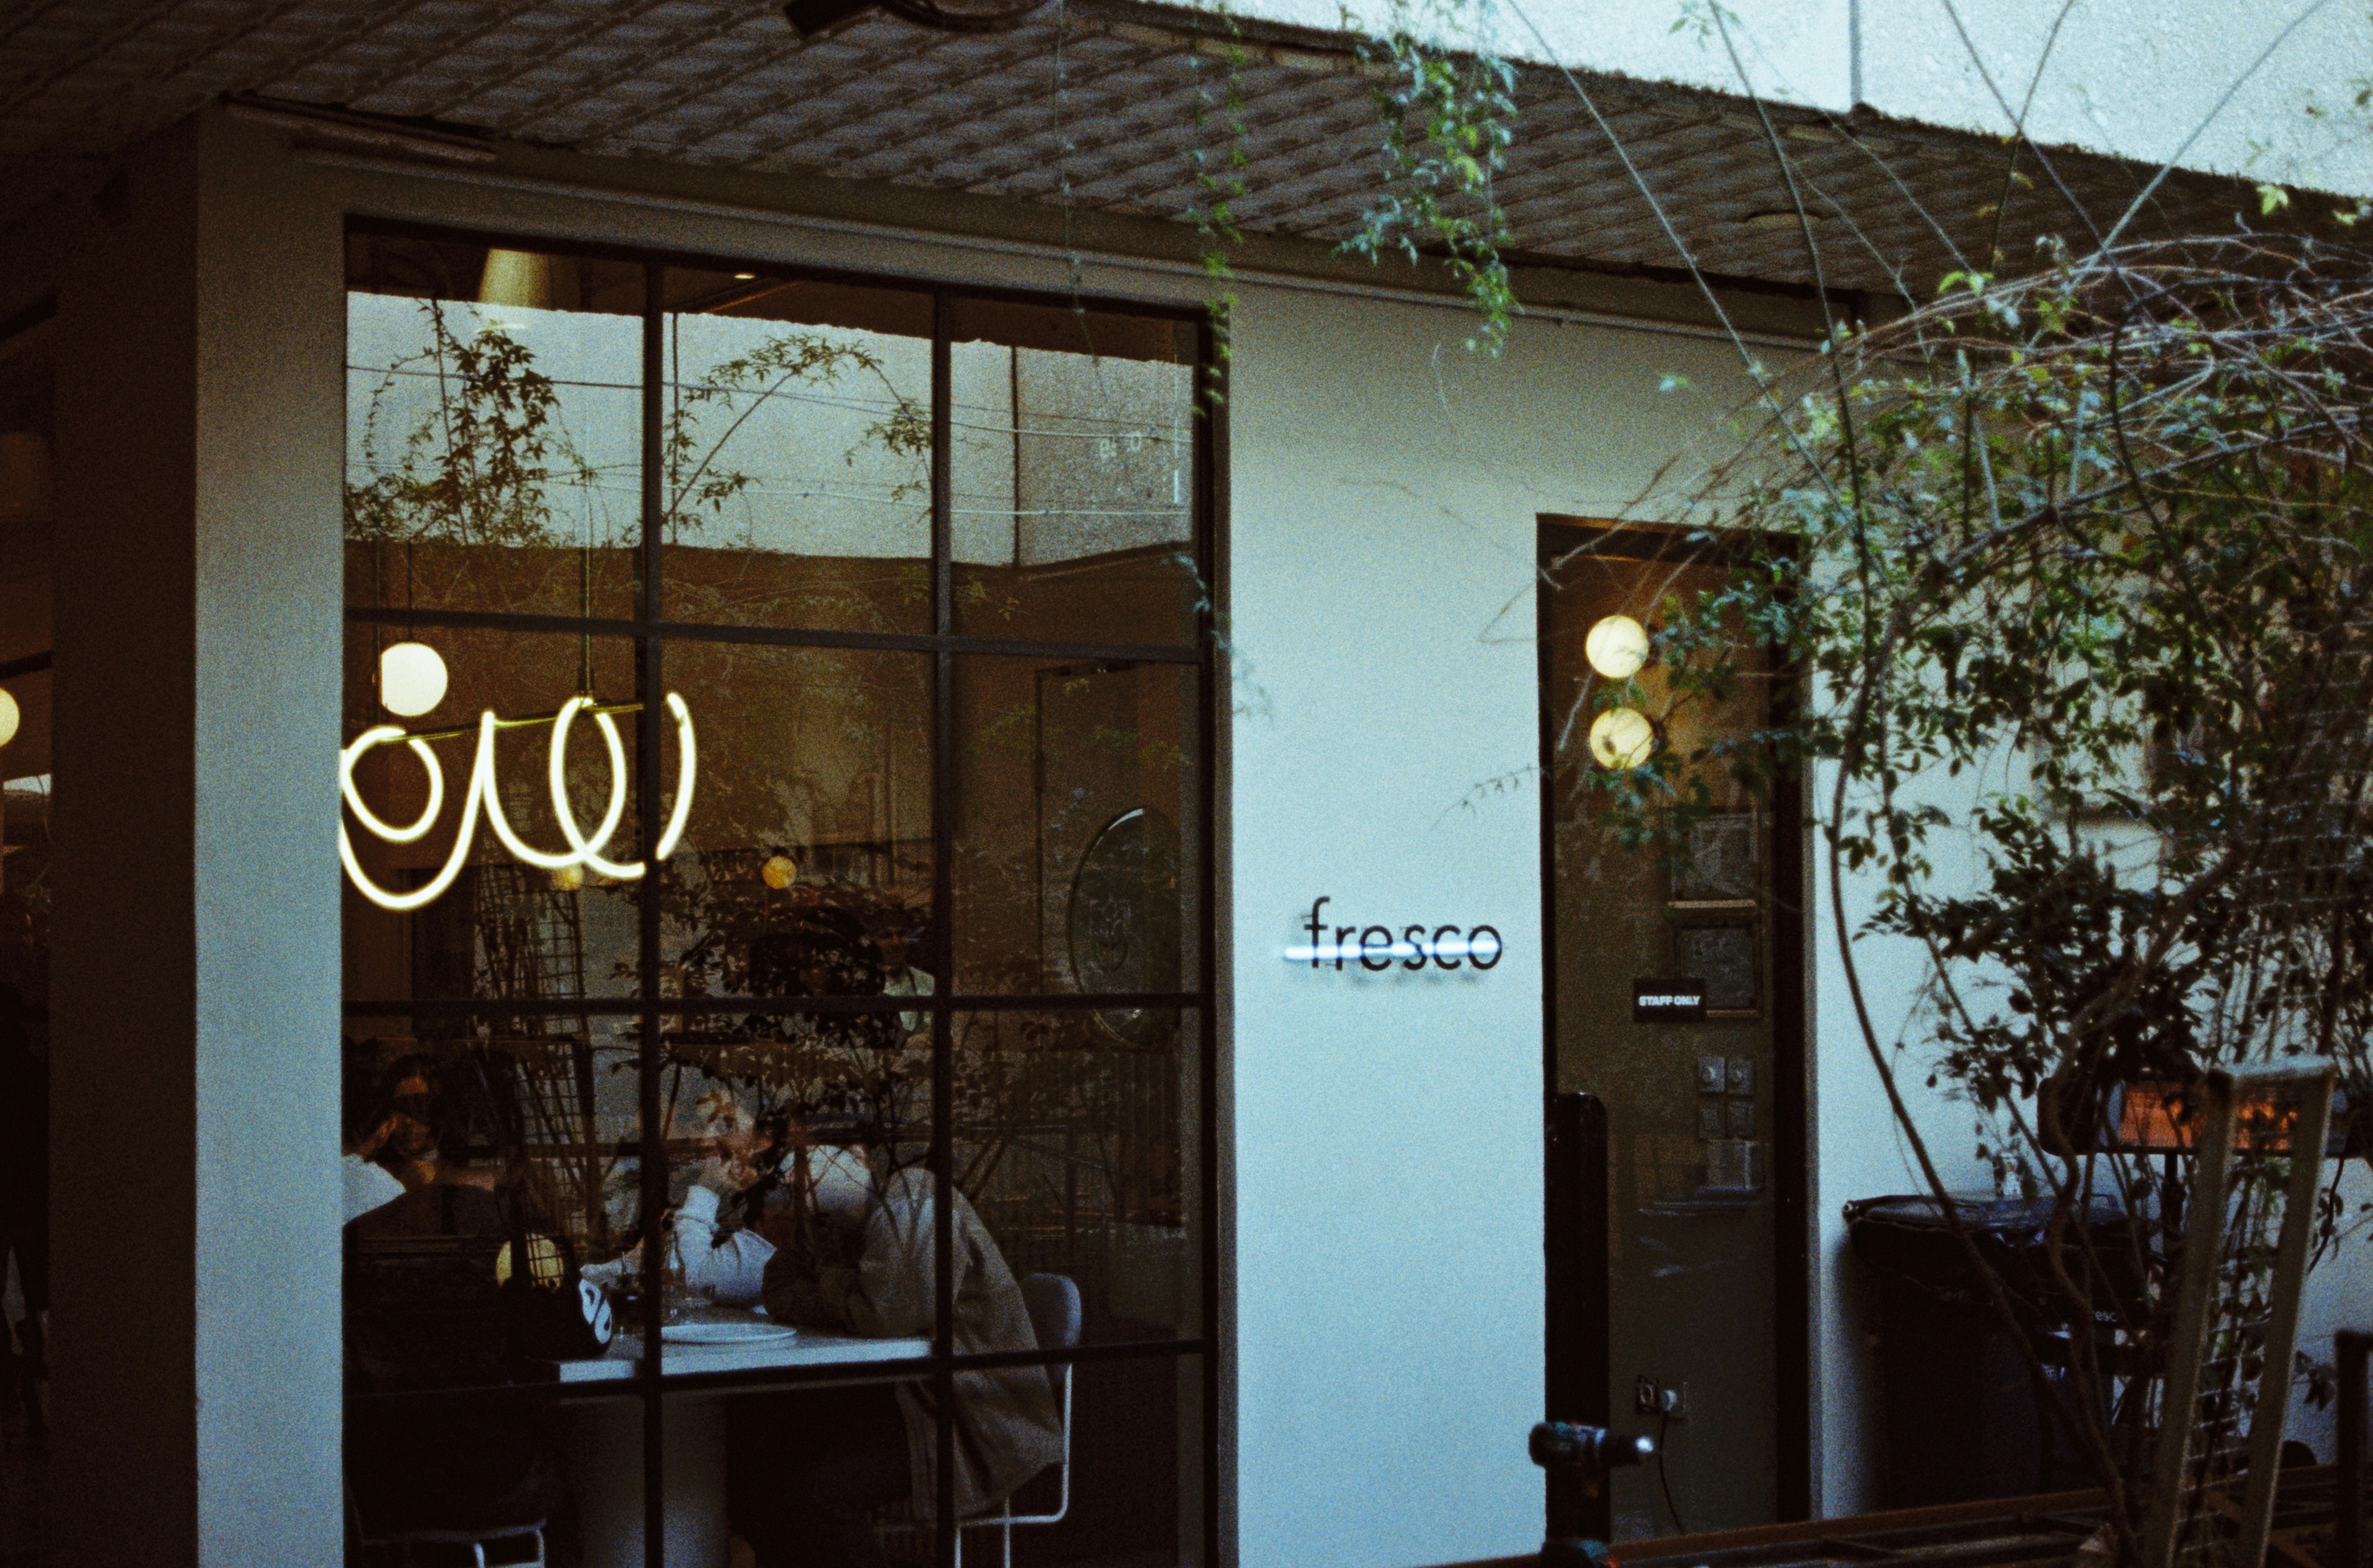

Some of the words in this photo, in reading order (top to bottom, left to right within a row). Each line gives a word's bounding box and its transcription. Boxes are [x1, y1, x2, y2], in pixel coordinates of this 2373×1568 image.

[1304, 896, 1502, 971] fresco
[1639, 995, 1673, 1006] STAFF
[1674, 995, 1700, 1006] ONLY
